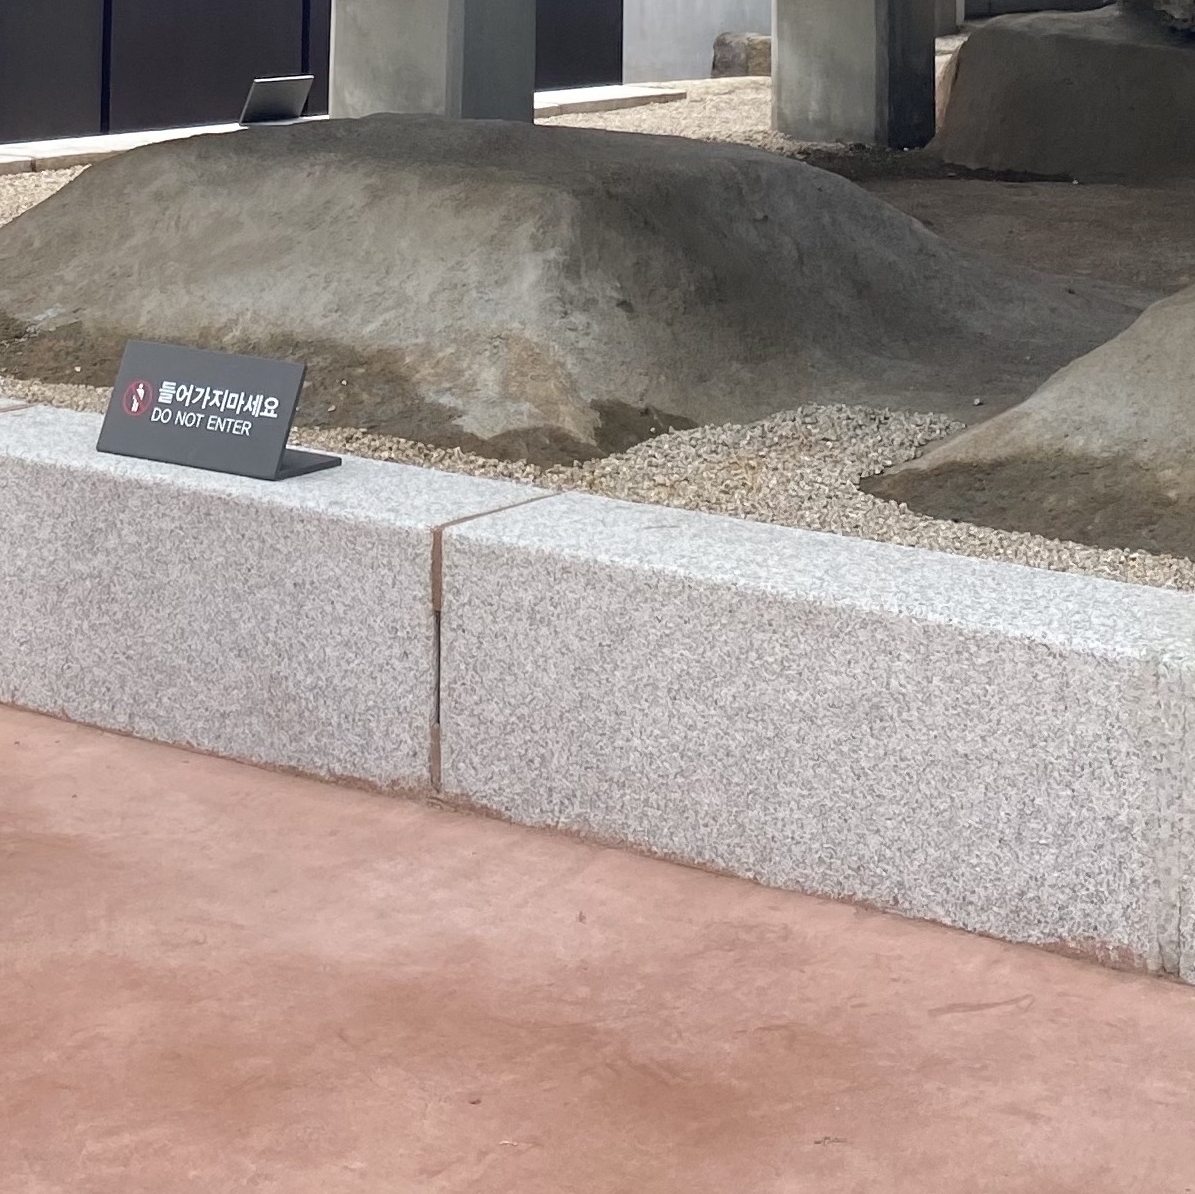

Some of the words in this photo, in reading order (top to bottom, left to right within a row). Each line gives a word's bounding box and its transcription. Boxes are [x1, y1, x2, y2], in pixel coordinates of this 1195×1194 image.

[157, 380, 280, 419] 들어가지마세요
[151, 407, 171, 424] DO
[174, 413, 204, 428] NOT
[206, 415, 253, 436] ENTER
